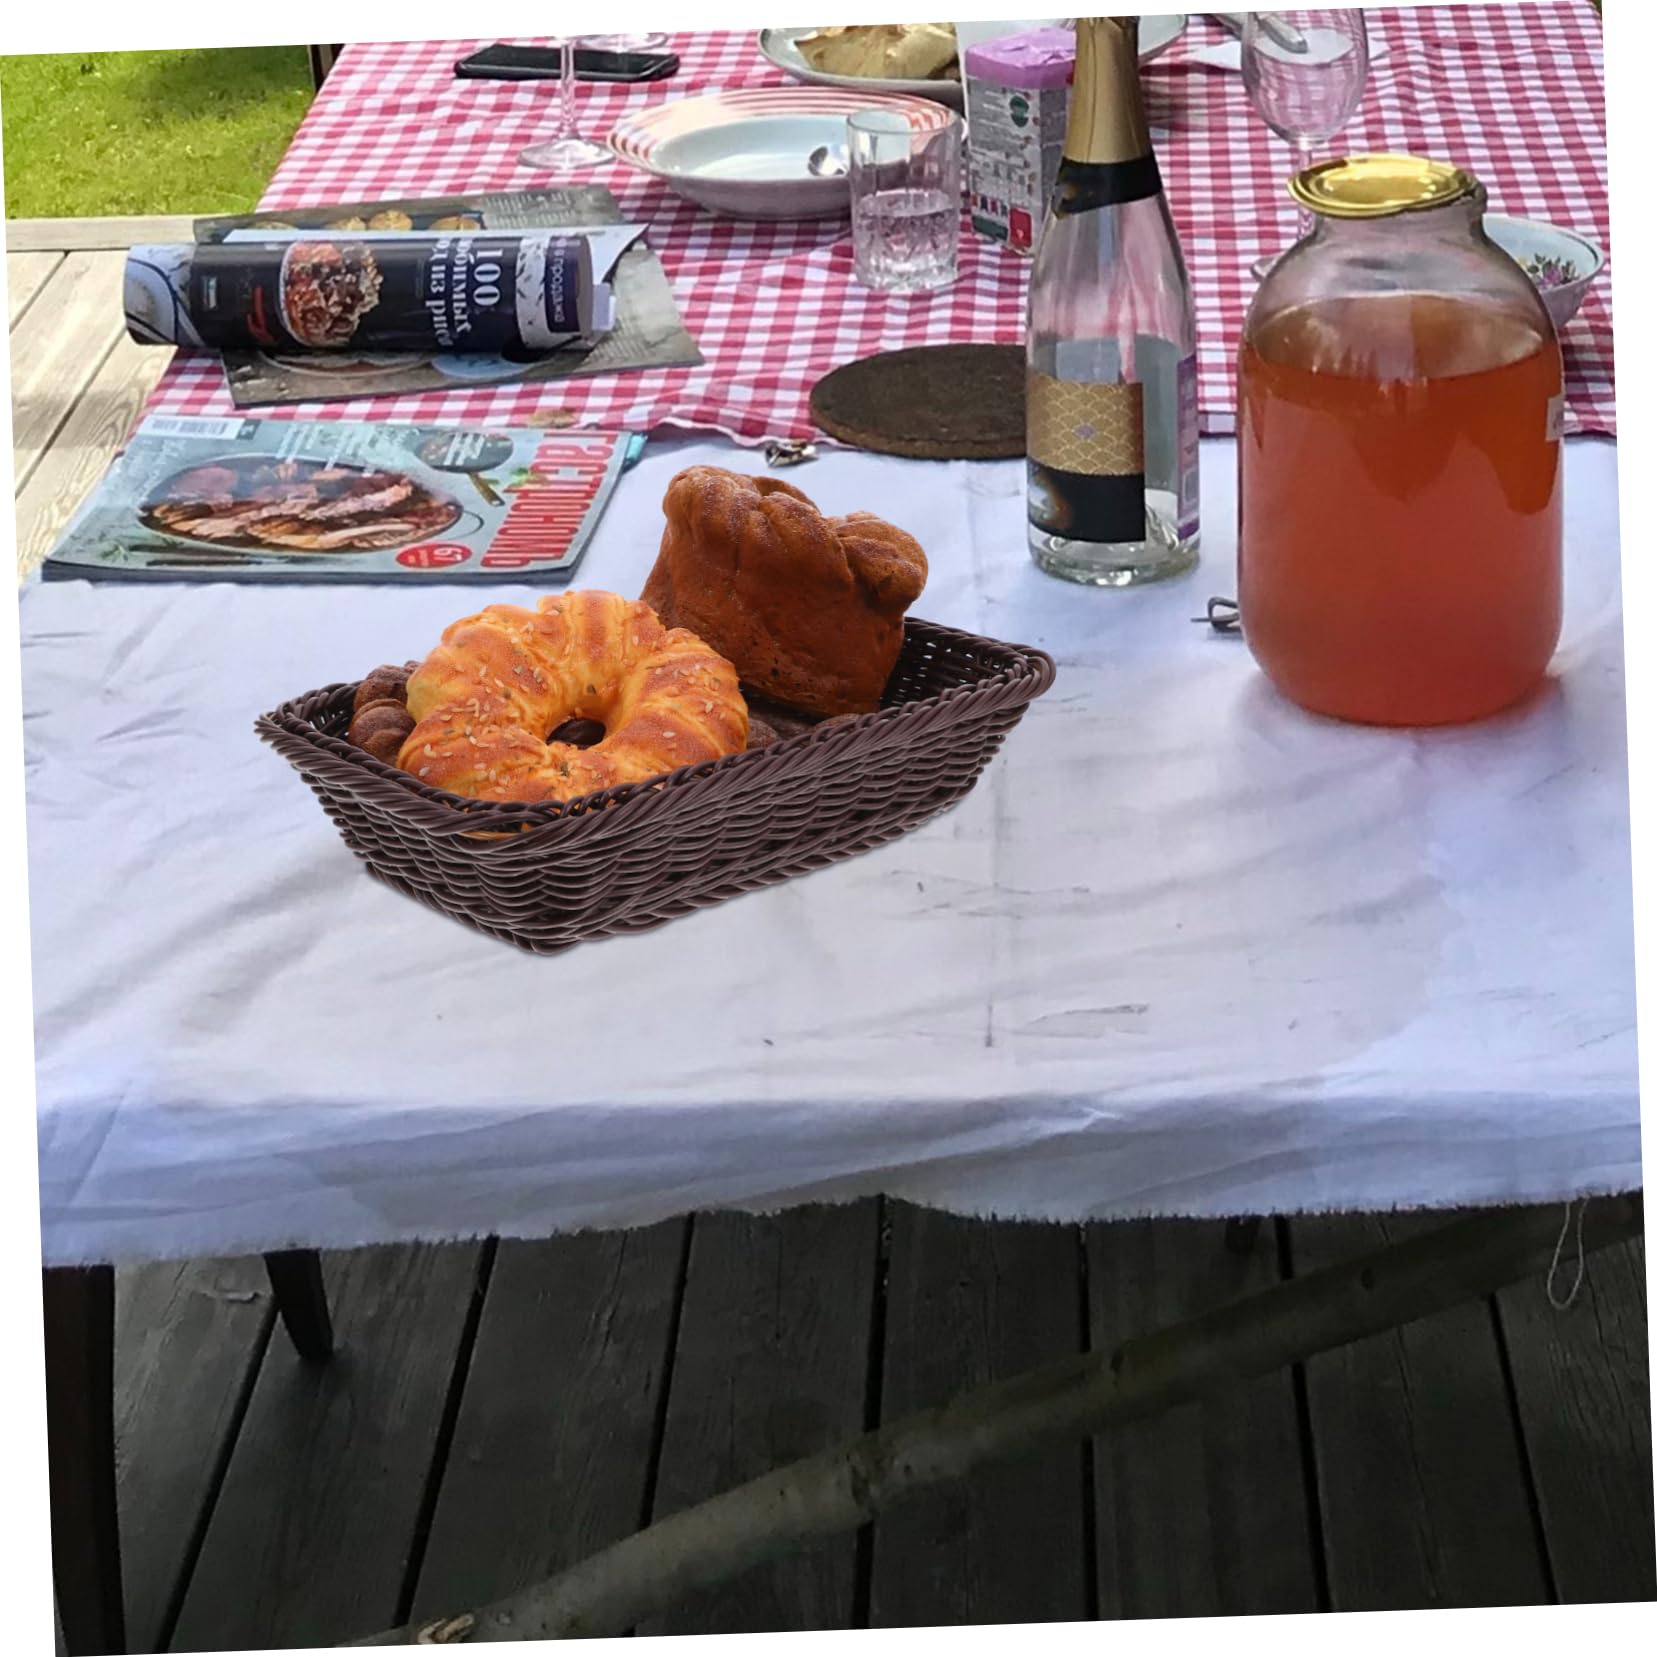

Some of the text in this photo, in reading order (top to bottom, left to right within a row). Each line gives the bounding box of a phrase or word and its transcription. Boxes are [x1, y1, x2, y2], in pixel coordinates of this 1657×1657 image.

[430, 264, 446, 294] из
[451, 238, 475, 334] юбимых
[473, 249, 504, 306] 100
